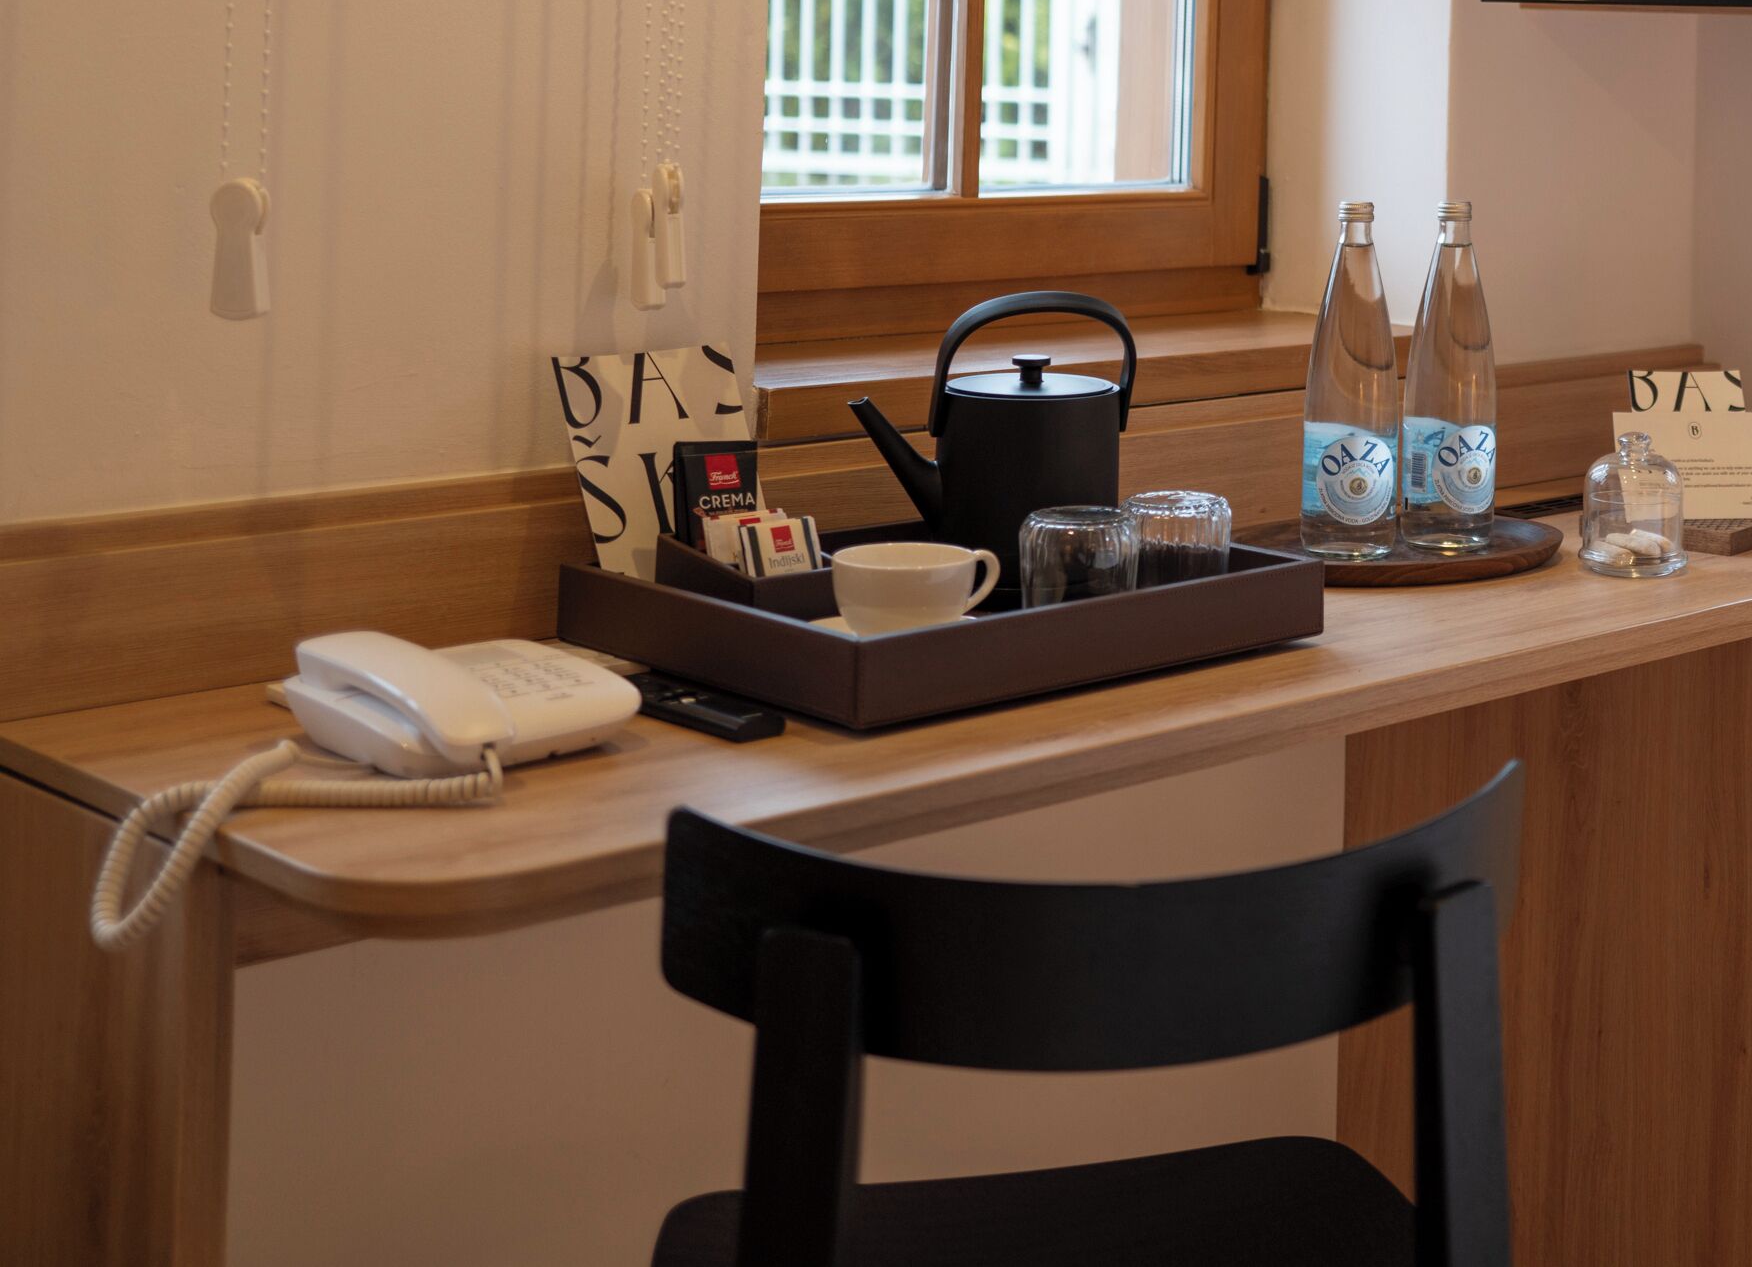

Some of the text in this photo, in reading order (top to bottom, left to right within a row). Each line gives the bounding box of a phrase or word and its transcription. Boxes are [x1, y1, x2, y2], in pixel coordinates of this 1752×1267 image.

[1321, 439, 1390, 477] OAZA
[1438, 430, 1496, 467] OAZA
[699, 492, 756, 510] CREMA
